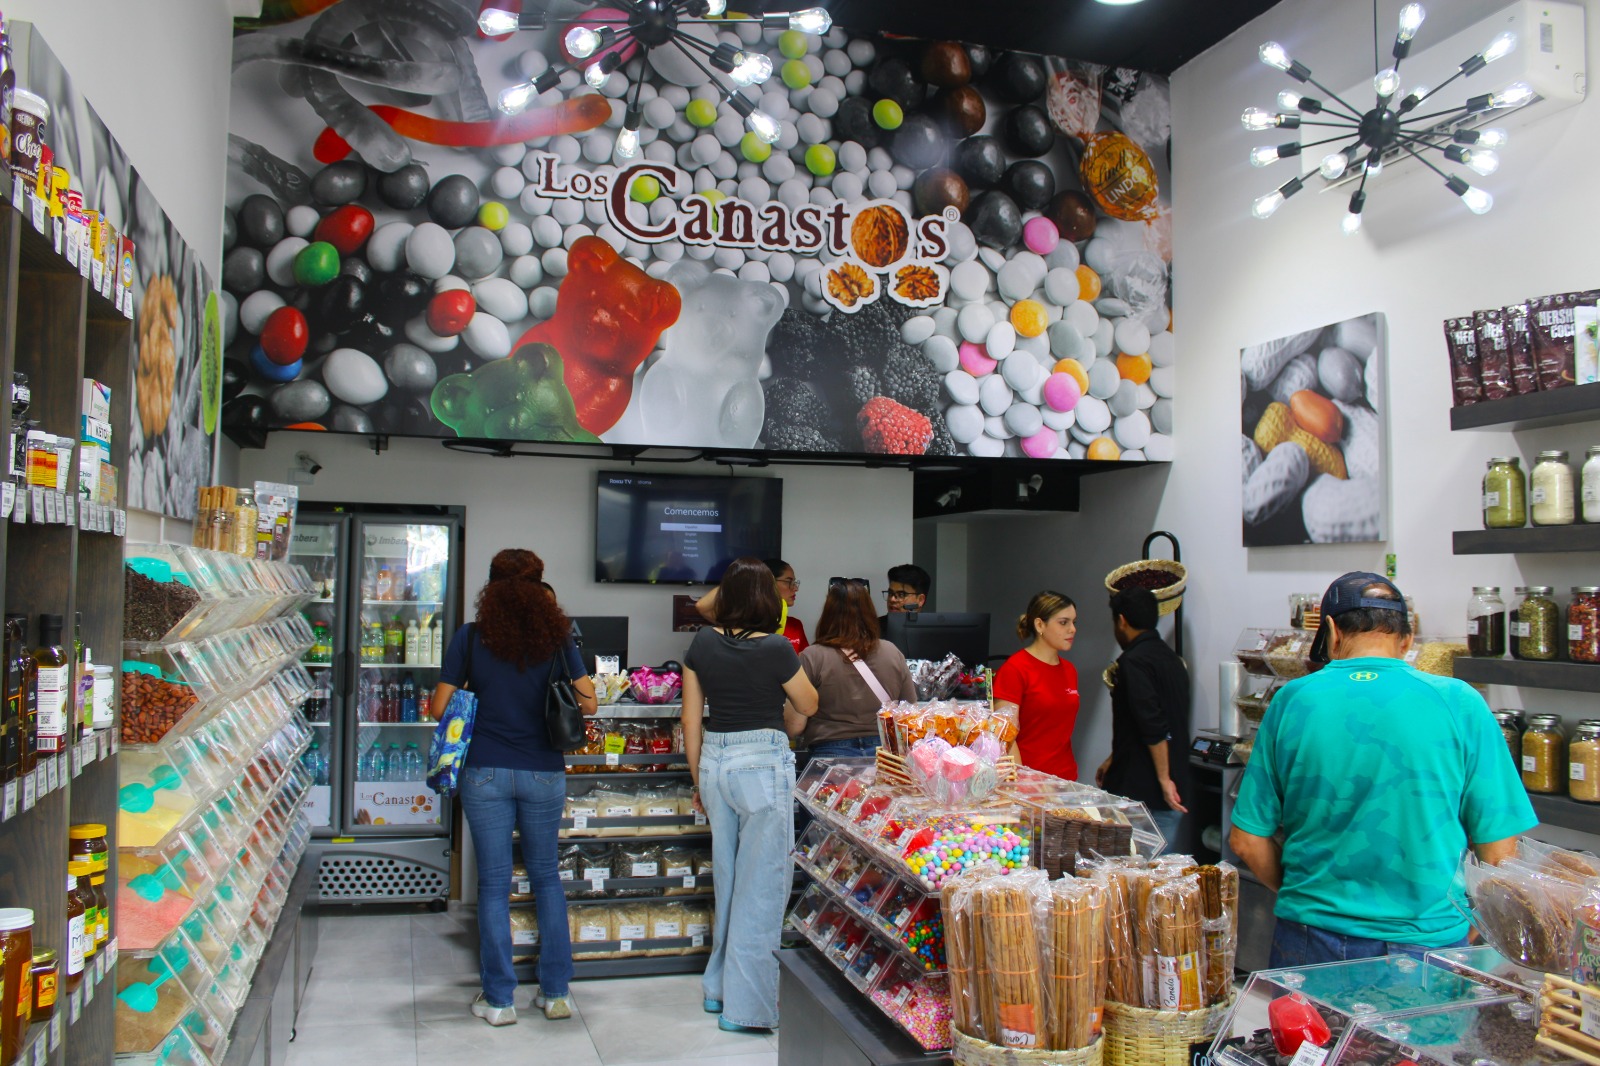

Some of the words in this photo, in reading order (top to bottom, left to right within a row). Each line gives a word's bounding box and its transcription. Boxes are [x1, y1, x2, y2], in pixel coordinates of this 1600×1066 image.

[540, 157, 609, 196] Los
[1105, 166, 1147, 204] LINDO
[1538, 308, 1575, 327] HERSH
[664, 506, 719, 517] Comencemos
